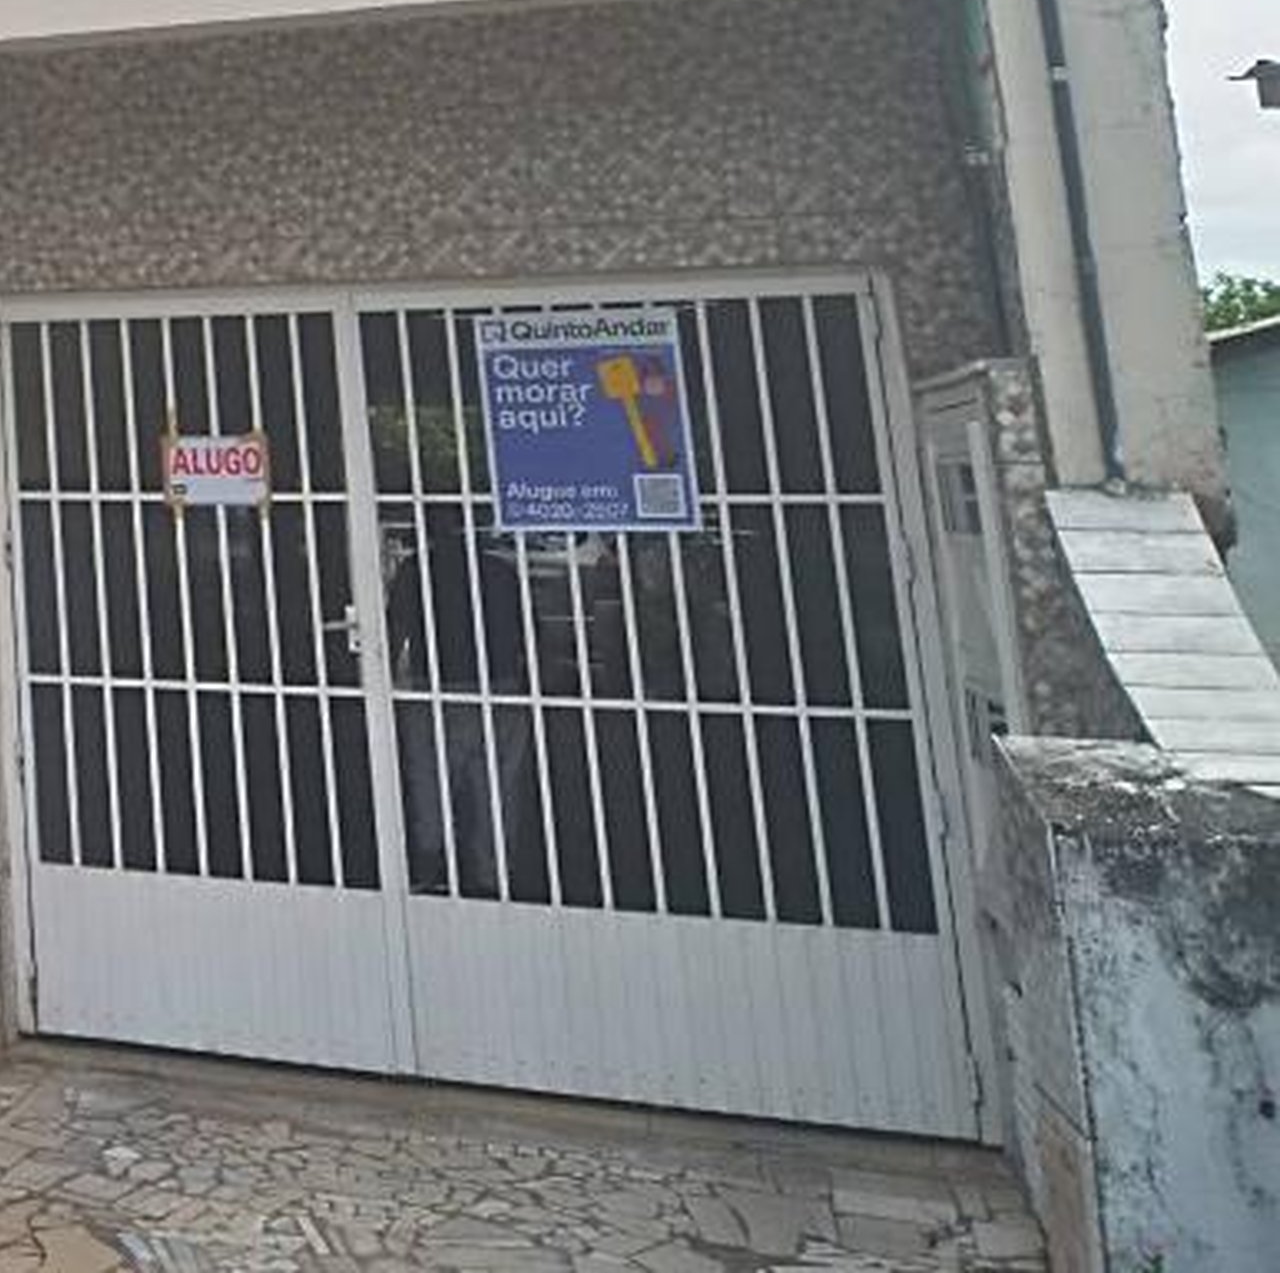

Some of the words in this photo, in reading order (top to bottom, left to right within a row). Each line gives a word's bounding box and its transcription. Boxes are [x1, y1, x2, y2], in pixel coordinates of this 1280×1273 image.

[510, 318, 668, 341] QuintoAndar
[493, 355, 572, 379] Quer
[497, 383, 592, 404] morar
[500, 404, 586, 434] aqui?
[173, 448, 262, 475] ALUGO
